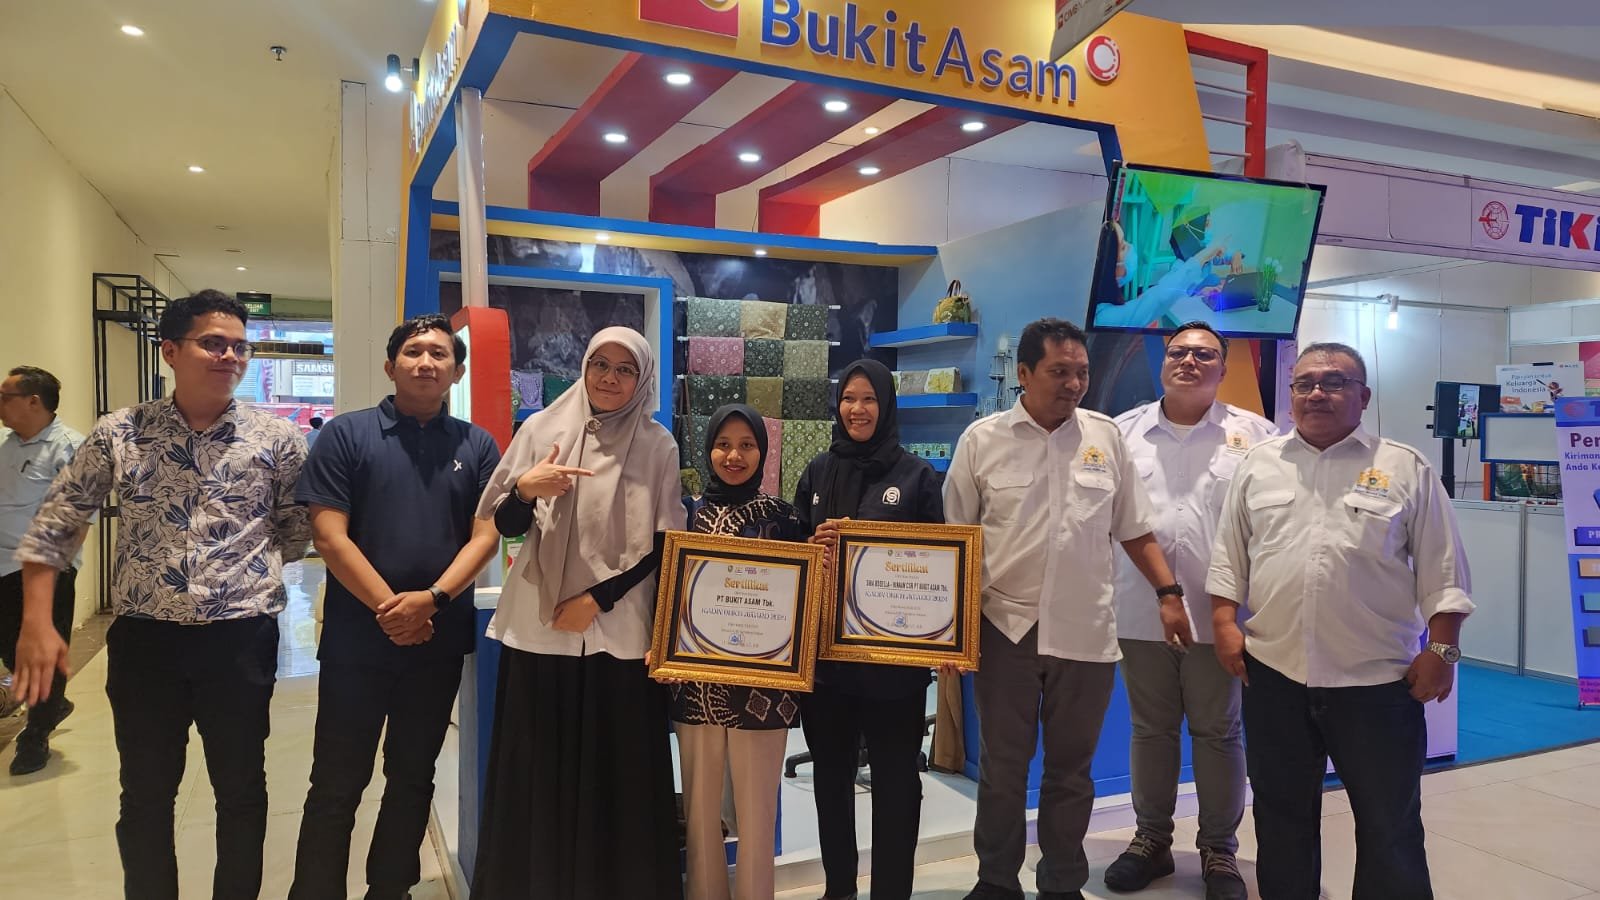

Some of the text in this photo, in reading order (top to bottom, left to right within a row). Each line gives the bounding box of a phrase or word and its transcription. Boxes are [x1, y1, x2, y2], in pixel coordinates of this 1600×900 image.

[760, 0, 1077, 102] Bukit Asam
[1506, 379, 1537, 388] Keluarga
[1512, 385, 1546, 393] Indonesia
[716, 594, 724, 603] PT
[725, 595, 743, 605] BUKIT
[744, 597, 761, 606] ASAM
